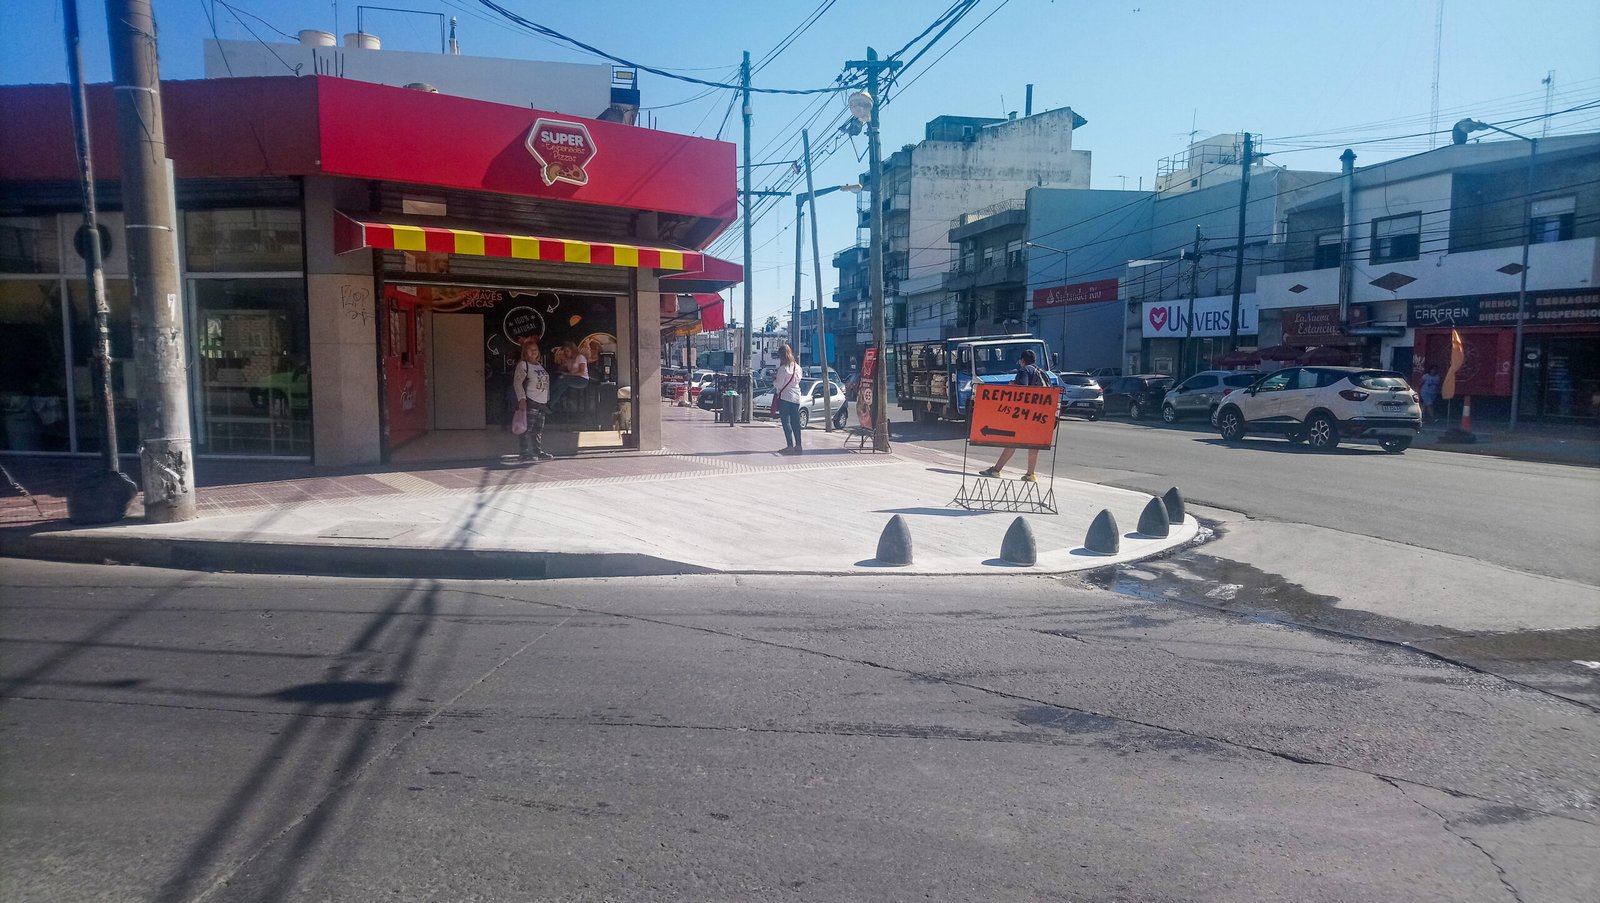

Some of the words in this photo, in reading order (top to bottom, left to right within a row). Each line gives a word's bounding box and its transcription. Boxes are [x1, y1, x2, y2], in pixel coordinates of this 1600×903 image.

[541, 131, 583, 147] SUPER
[552, 150, 577, 162] Pizzas
[1479, 299, 1518, 309] FRENOS
[1415, 307, 1469, 324] CARFREN
[1537, 308, 1600, 319] SUSPENSIO
[1297, 322, 1336, 335] Estancia
[982, 388, 1053, 406] REMISERIA
[997, 404, 1012, 415] LAS
[1011, 406, 1030, 420] 24
[1032, 411, 1049, 425] HS
